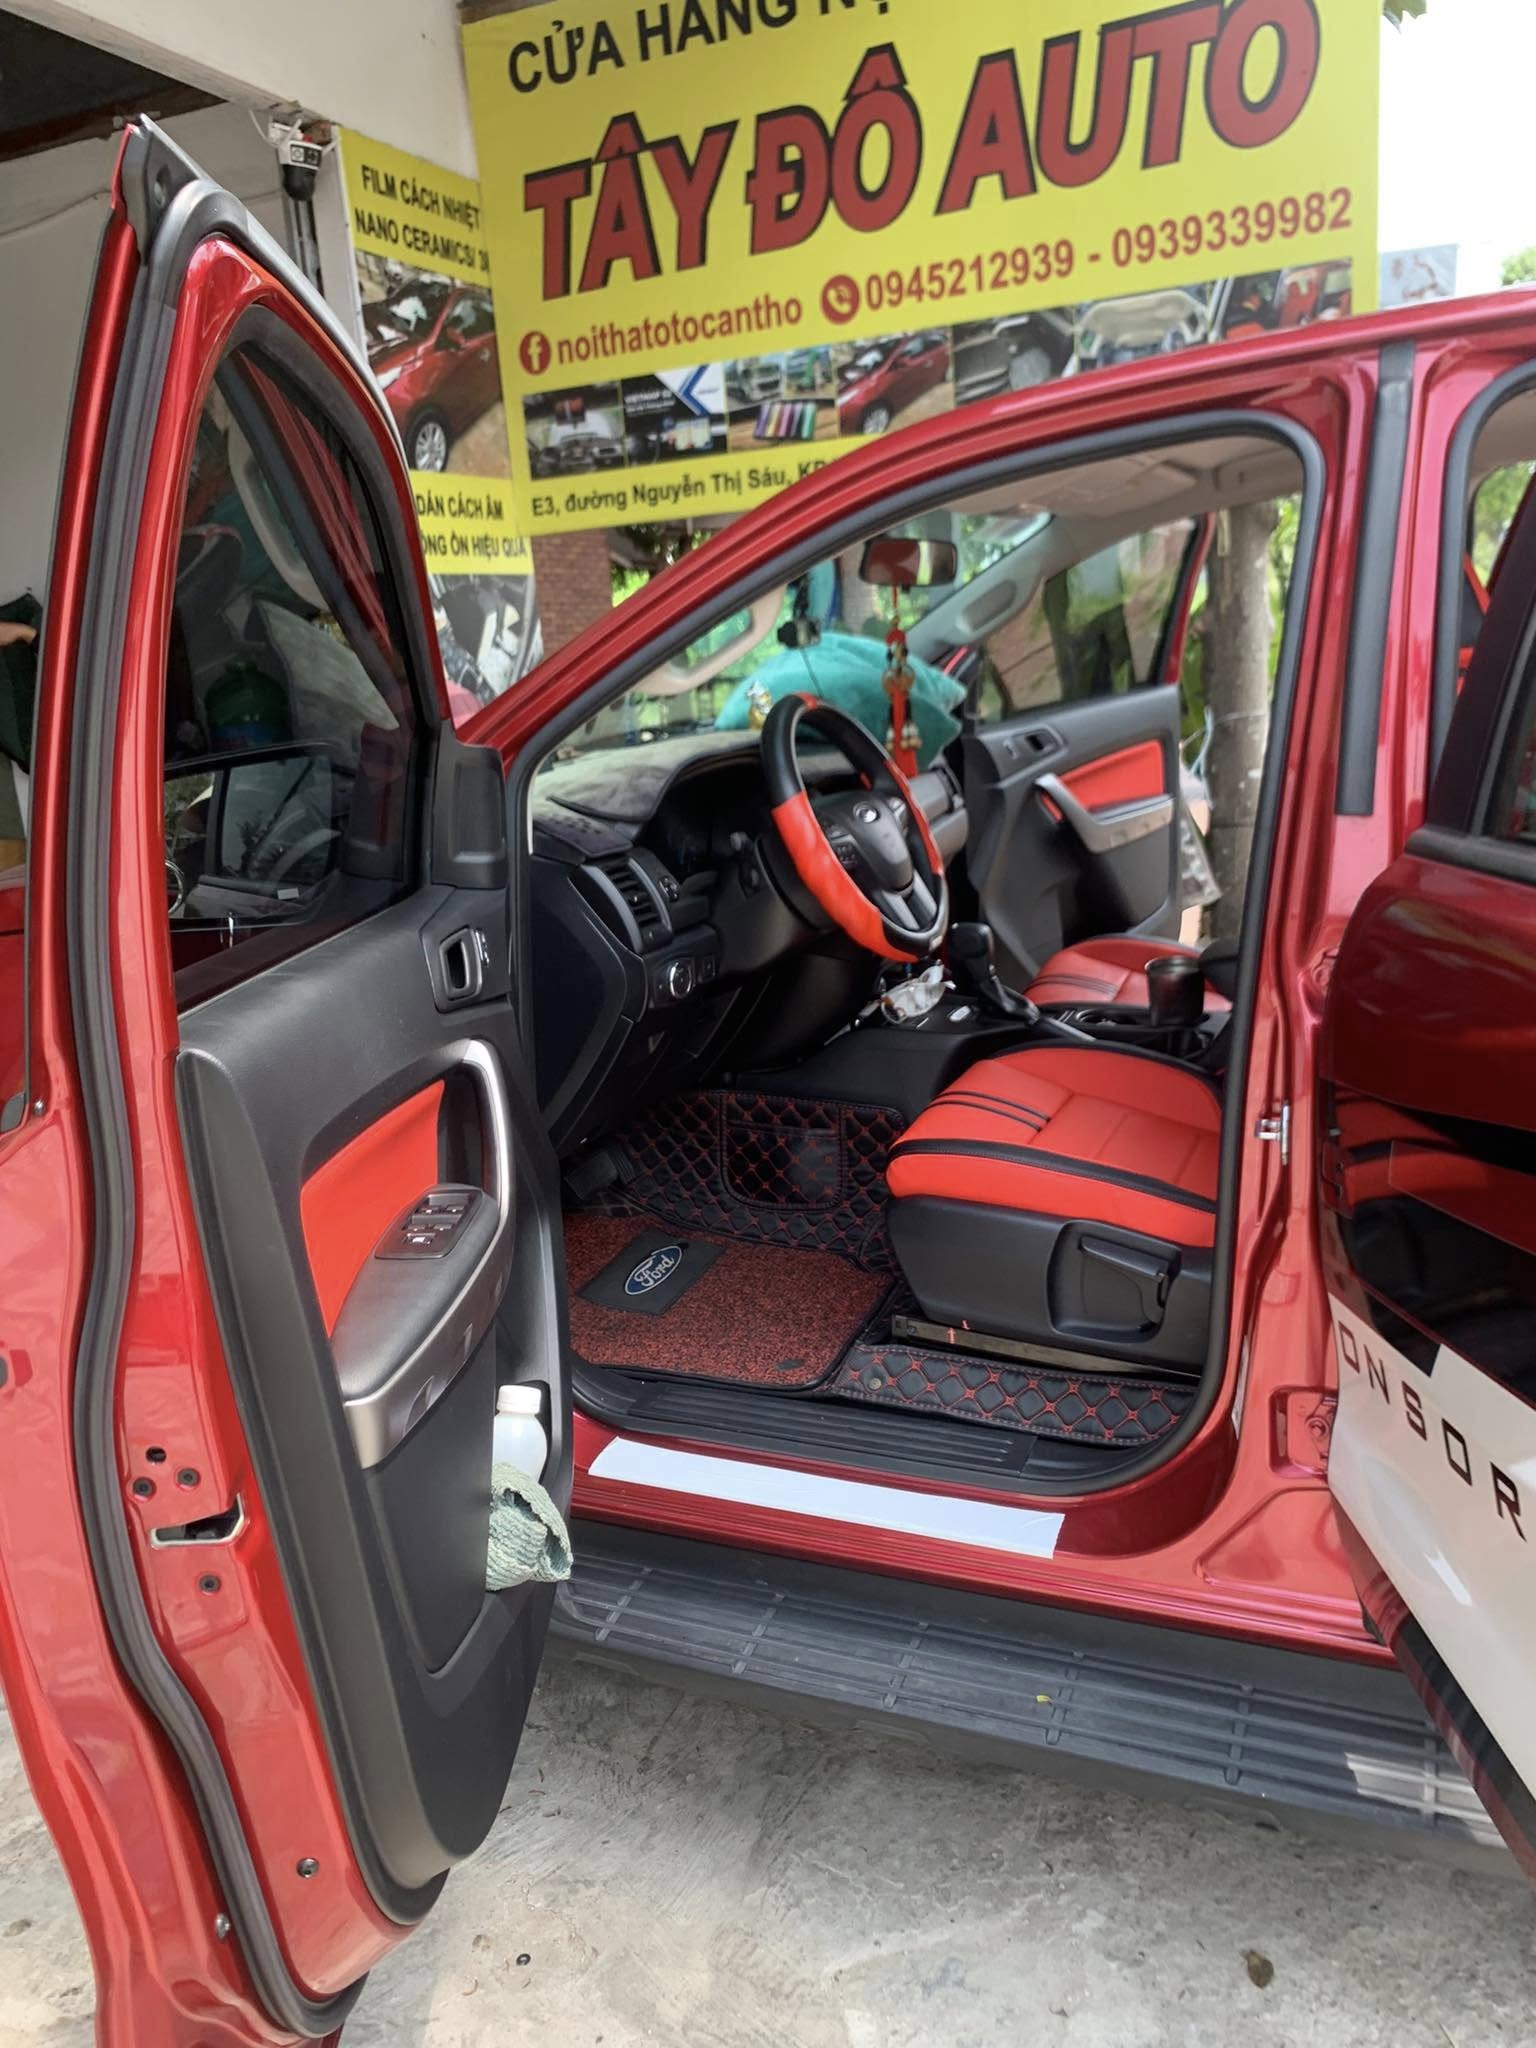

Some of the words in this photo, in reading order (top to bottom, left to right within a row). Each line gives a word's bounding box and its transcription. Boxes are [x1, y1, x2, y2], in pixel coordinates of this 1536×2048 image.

[508, 19, 626, 94] CỬA
[523, 111, 740, 301] TÂY
[745, 41, 923, 256] ĐÔ
[933, 0, 1321, 216] AUTO
[361, 163, 398, 200] FILM
[400, 177, 441, 217] CÁCH
[354, 207, 399, 245] NANO
[864, 239, 1075, 312] 0945212939
[1111, 186, 1353, 268] 0939339982
[556, 294, 803, 364] noithatotocantho
[415, 488, 446, 518] DÁN
[448, 490, 484, 520] CÁCH
[532, 495, 560, 517] E3,
[565, 488, 628, 512] đường
[632, 472, 706, 507] Nguyễn
[710, 469, 742, 496] Thị
[633, 1254, 675, 1287] Ford
